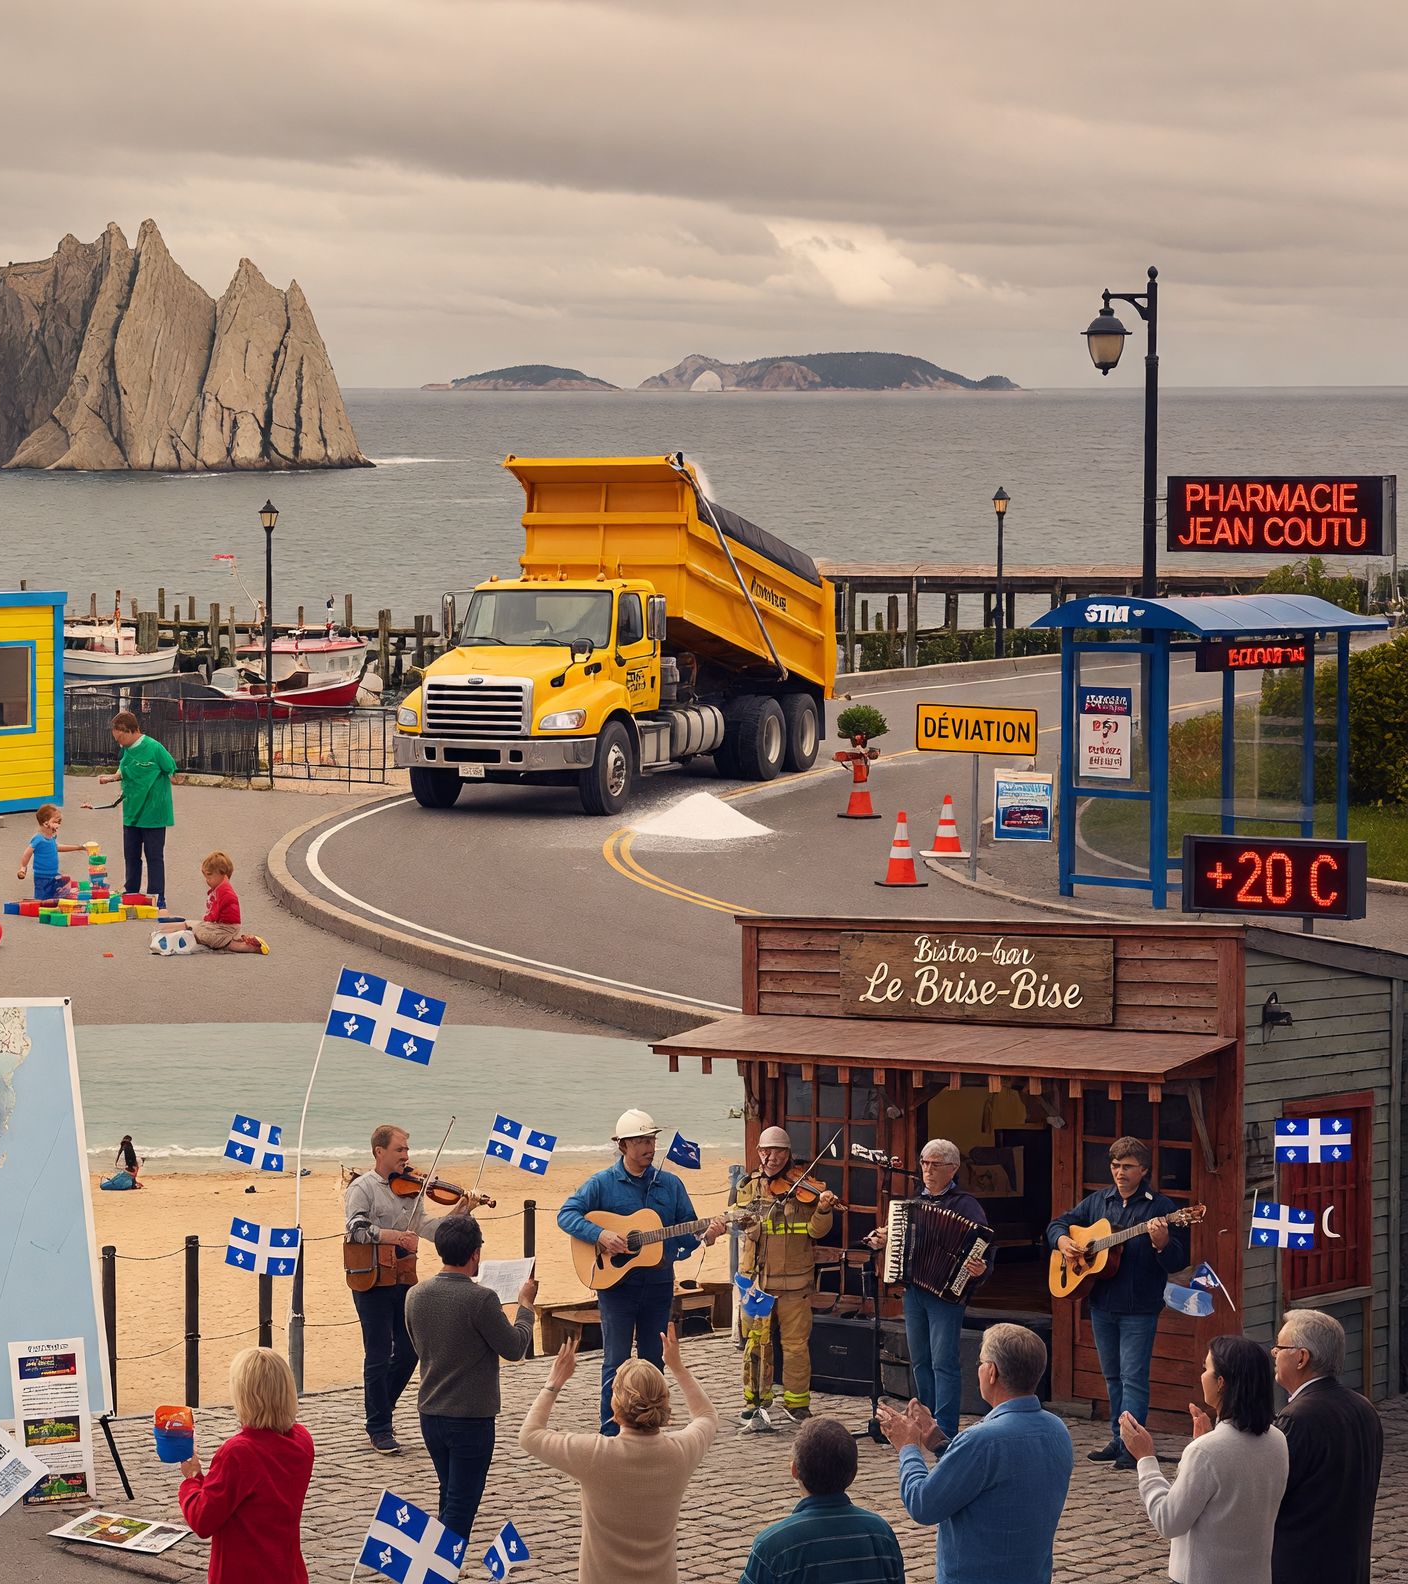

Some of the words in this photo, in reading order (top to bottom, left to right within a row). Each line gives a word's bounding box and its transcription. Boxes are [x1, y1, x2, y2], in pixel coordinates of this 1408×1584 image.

[1185, 483, 1358, 513] PHARMACIE
[1178, 517, 1254, 546] JEAN
[1264, 518, 1367, 547] COUTU
[924, 712, 1031, 743] DÉVIATION
[1207, 852, 1293, 904] +20
[1310, 855, 1338, 906] C
[860, 963, 903, 1003] Le
[911, 965, 1083, 1010] Brise-Bise
